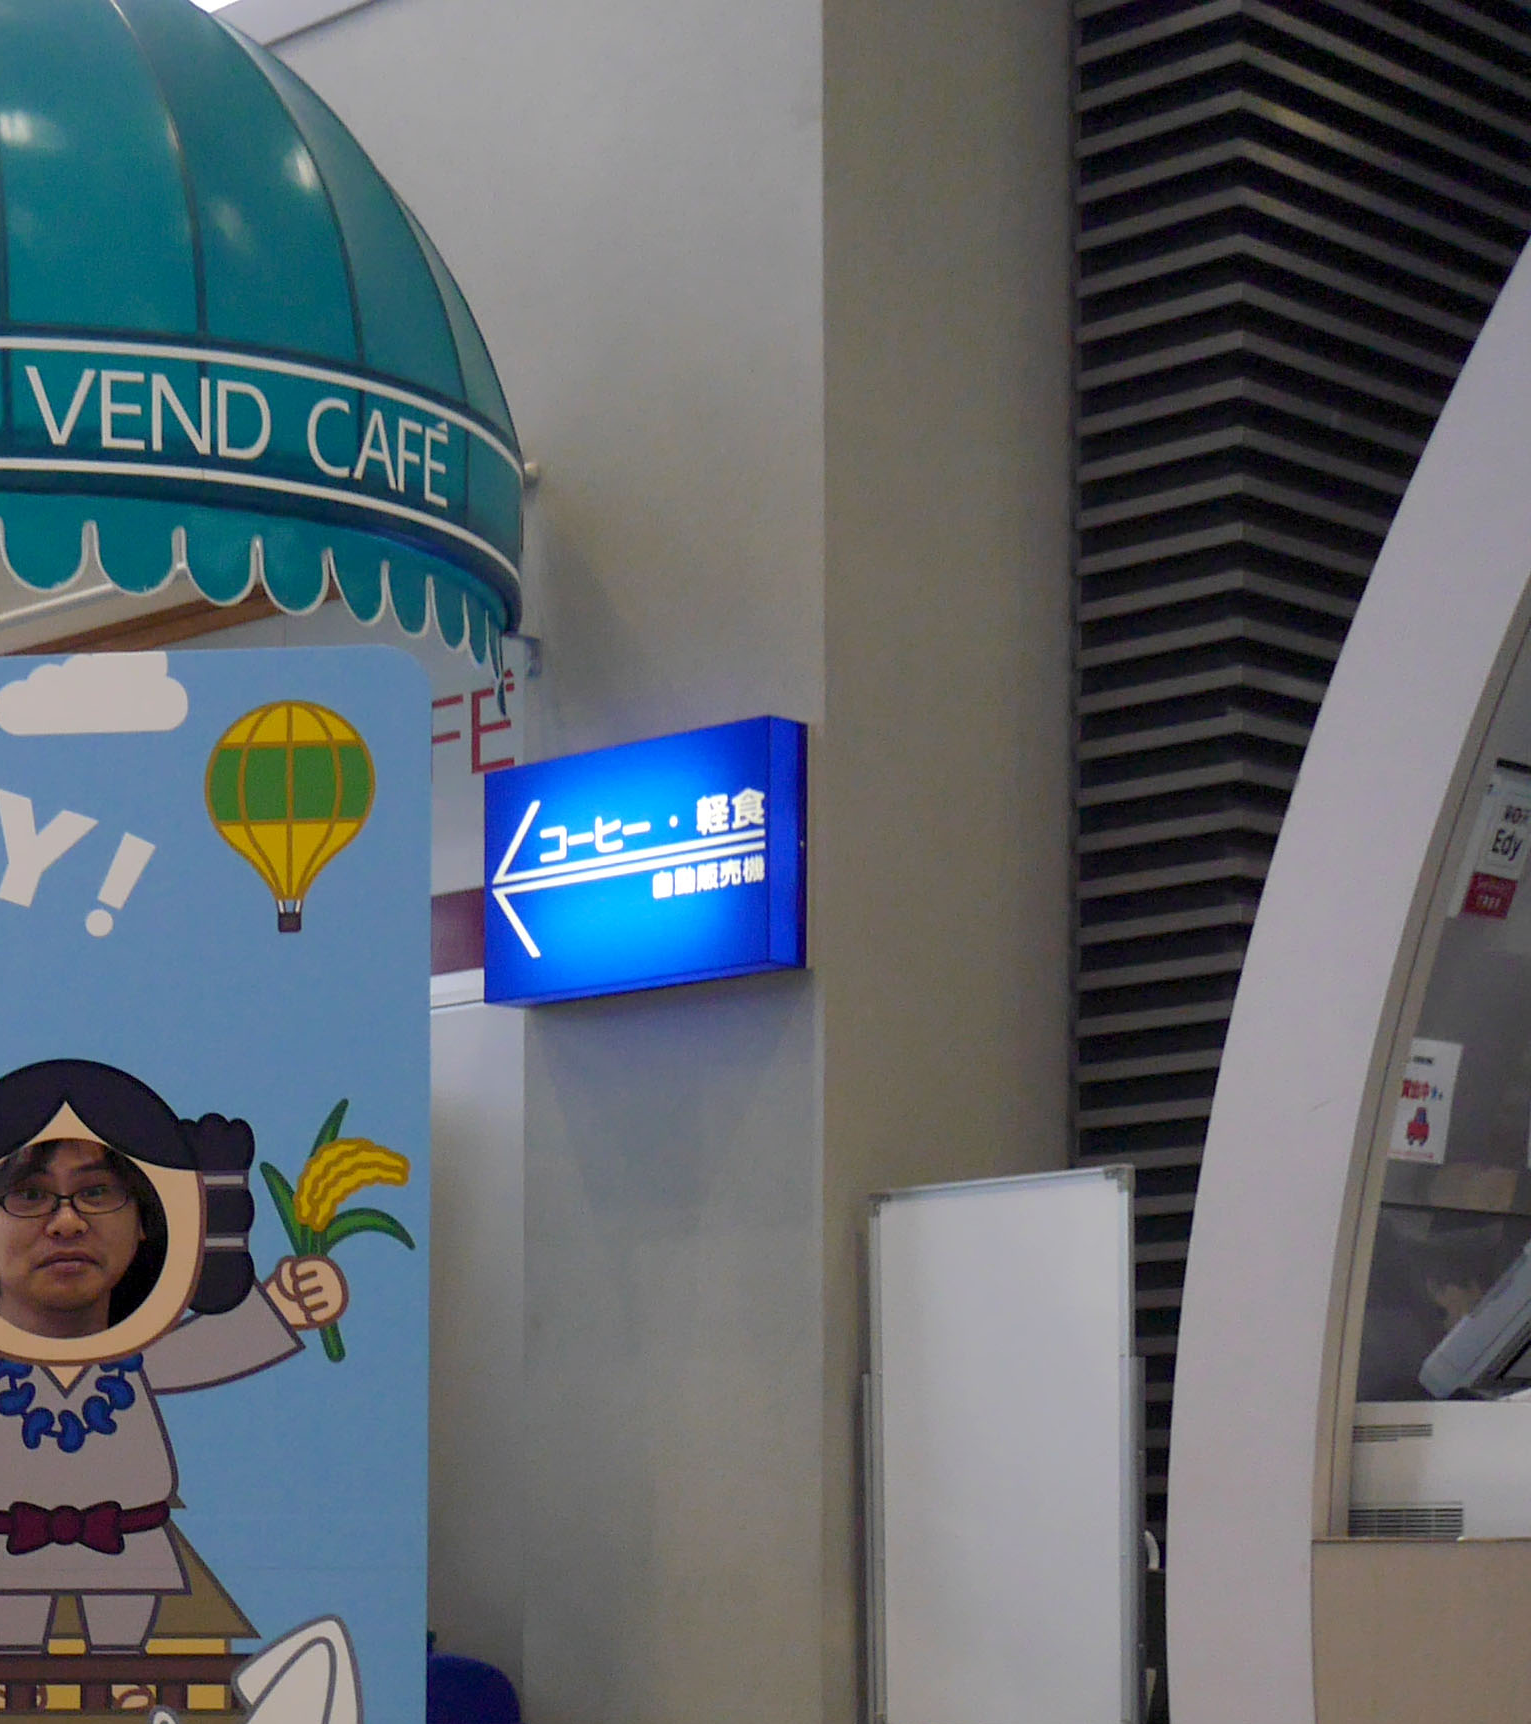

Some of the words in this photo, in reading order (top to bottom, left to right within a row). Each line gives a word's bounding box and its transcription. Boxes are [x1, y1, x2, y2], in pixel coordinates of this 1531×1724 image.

[25, 365, 272, 461] VEND
[306, 398, 450, 509] CAFÉ
[1491, 828, 1524, 862] Edy
